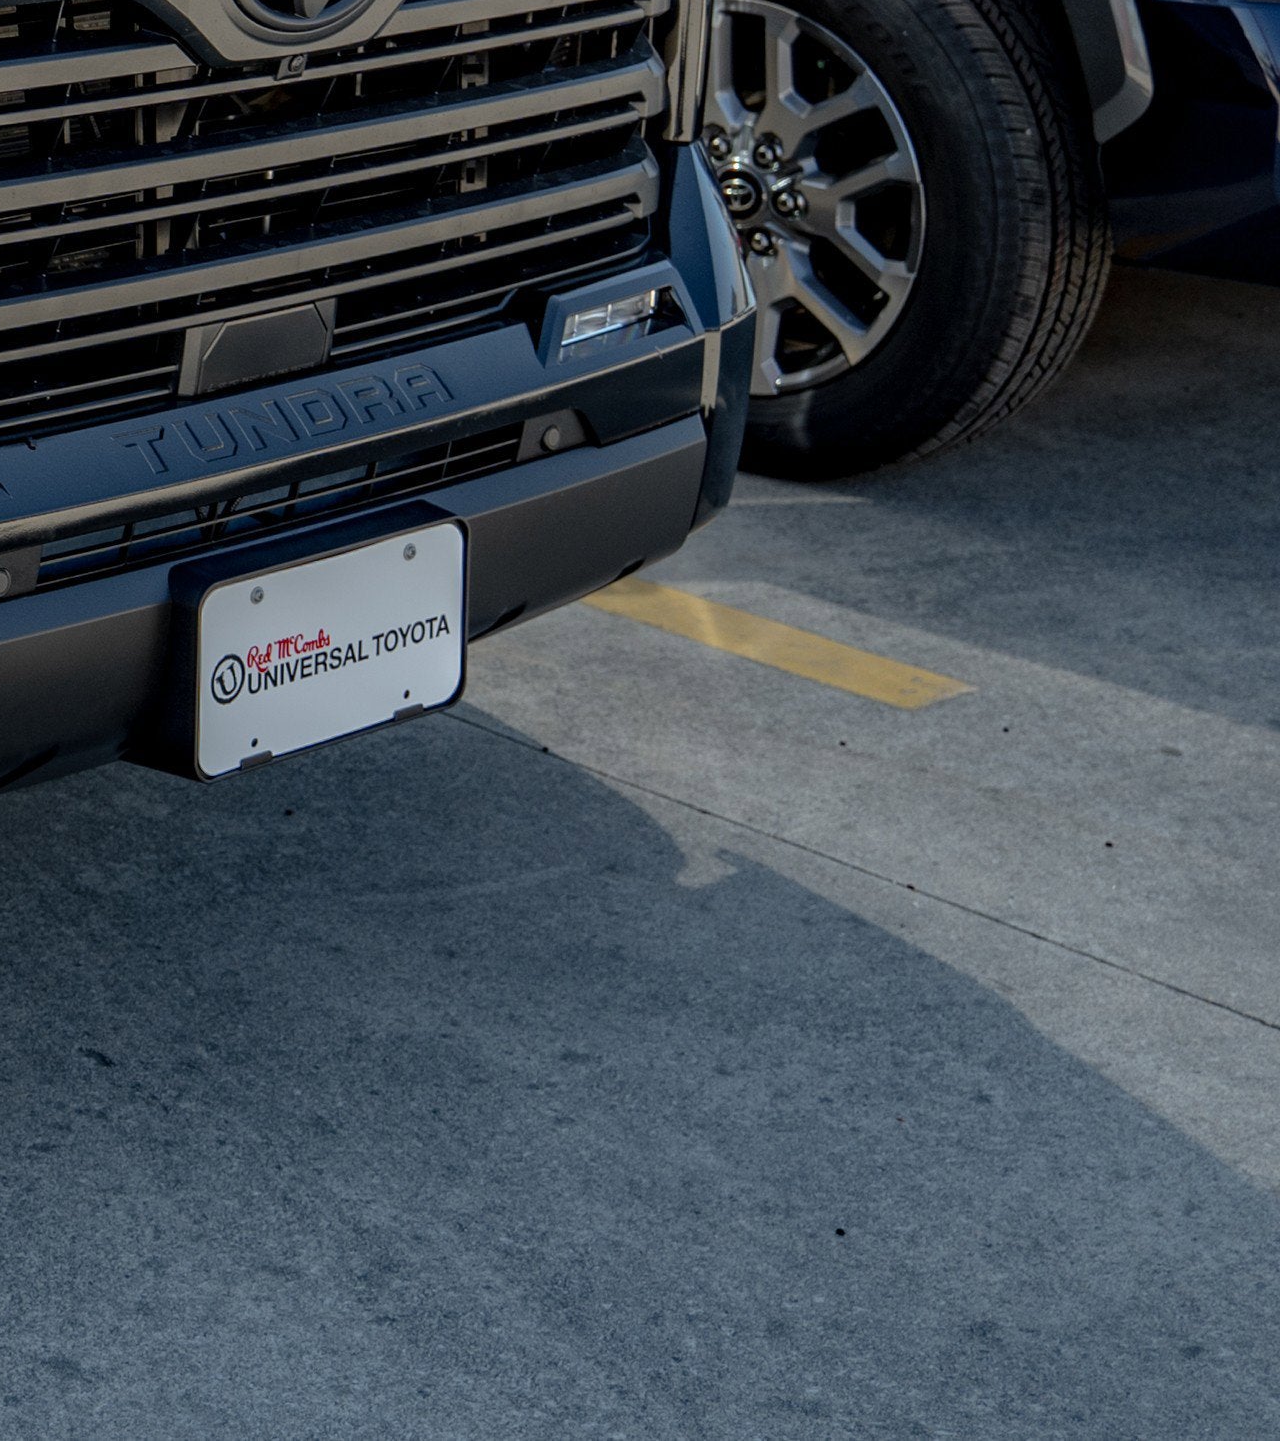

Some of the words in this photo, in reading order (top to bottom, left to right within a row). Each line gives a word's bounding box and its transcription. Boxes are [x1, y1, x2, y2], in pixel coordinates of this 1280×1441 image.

[110, 363, 454, 474] TUNDRA
[247, 641, 369, 694] UNIVERSAL
[372, 615, 450, 656] TOYOTA
[247, 642, 272, 672] Red
